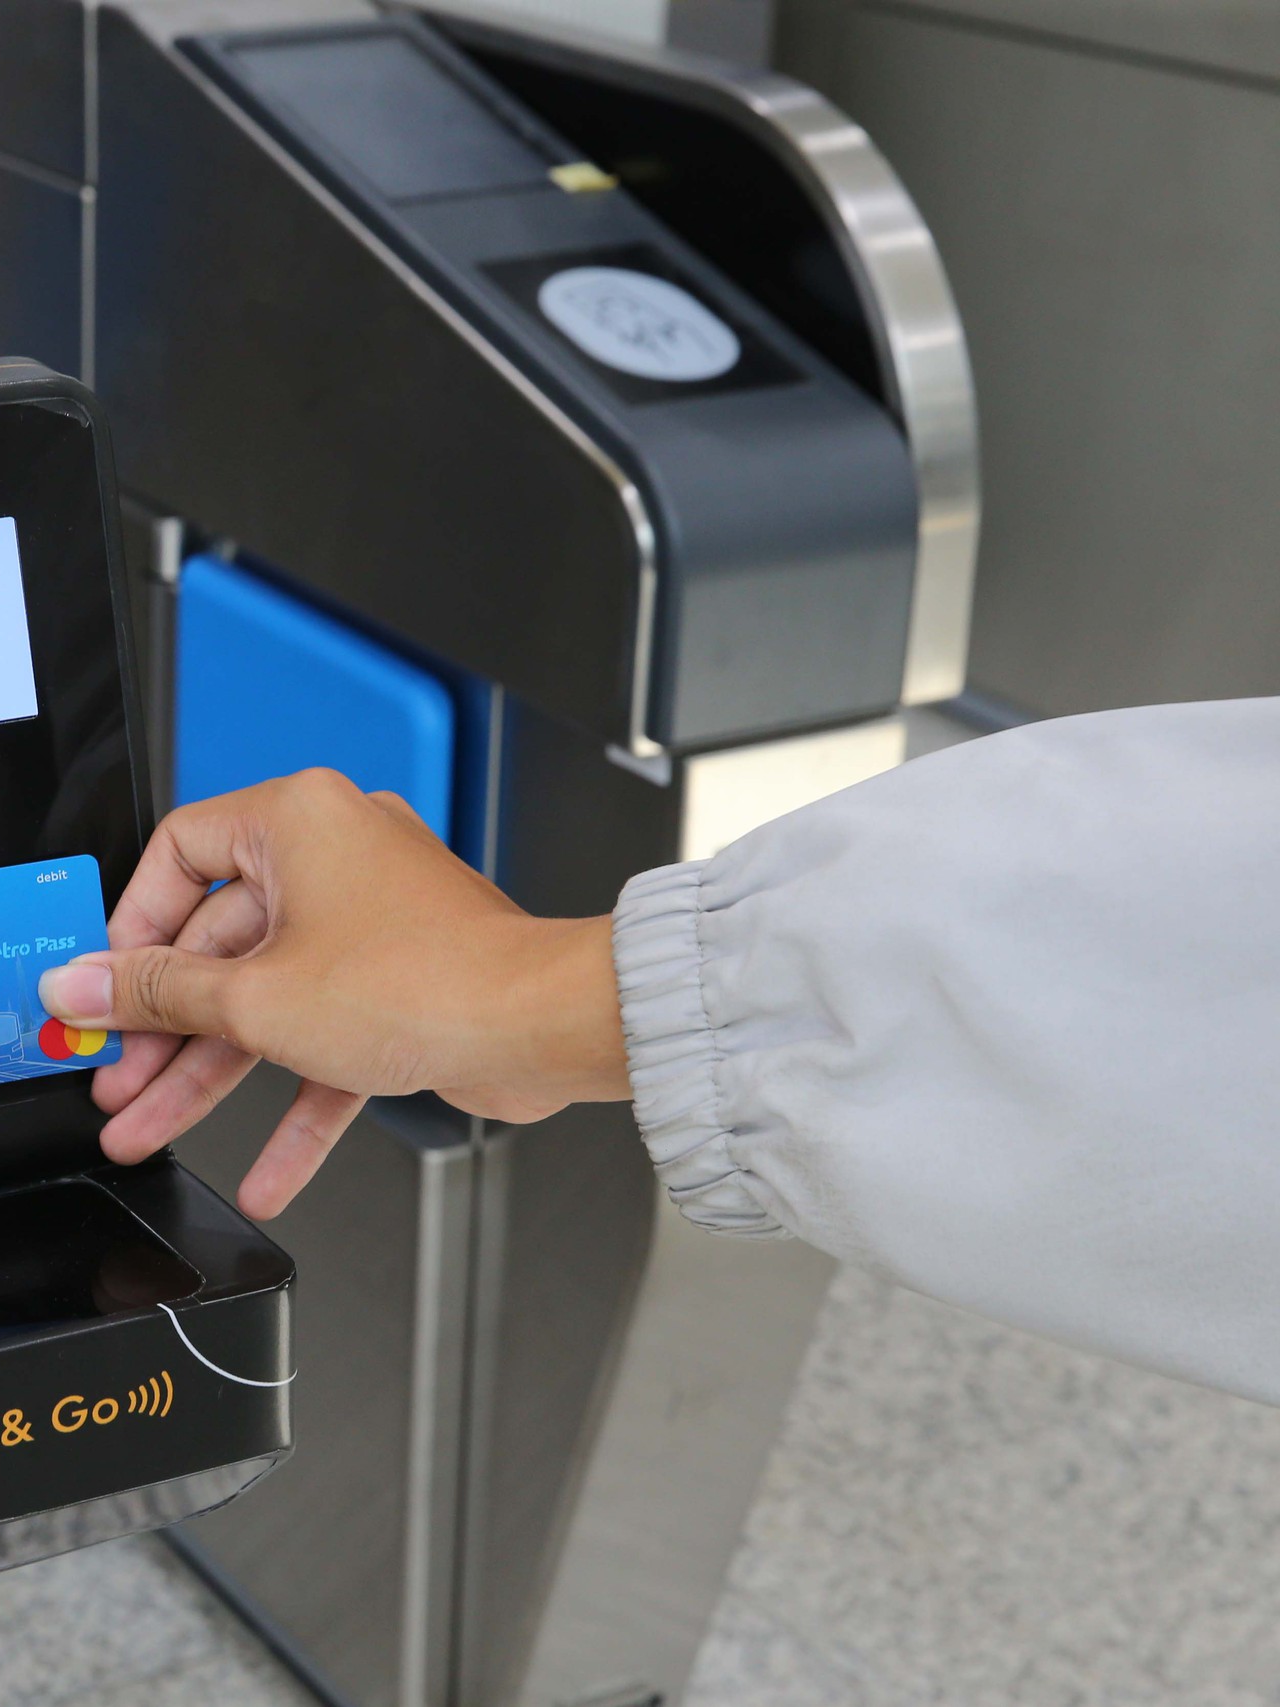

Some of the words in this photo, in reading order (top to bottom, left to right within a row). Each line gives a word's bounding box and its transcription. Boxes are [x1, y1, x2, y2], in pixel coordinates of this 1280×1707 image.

[36, 869, 68, 884] debit
[35, 935, 77, 954] Pass
[0, 1408, 34, 1447] &
[51, 1394, 120, 1433] Go
